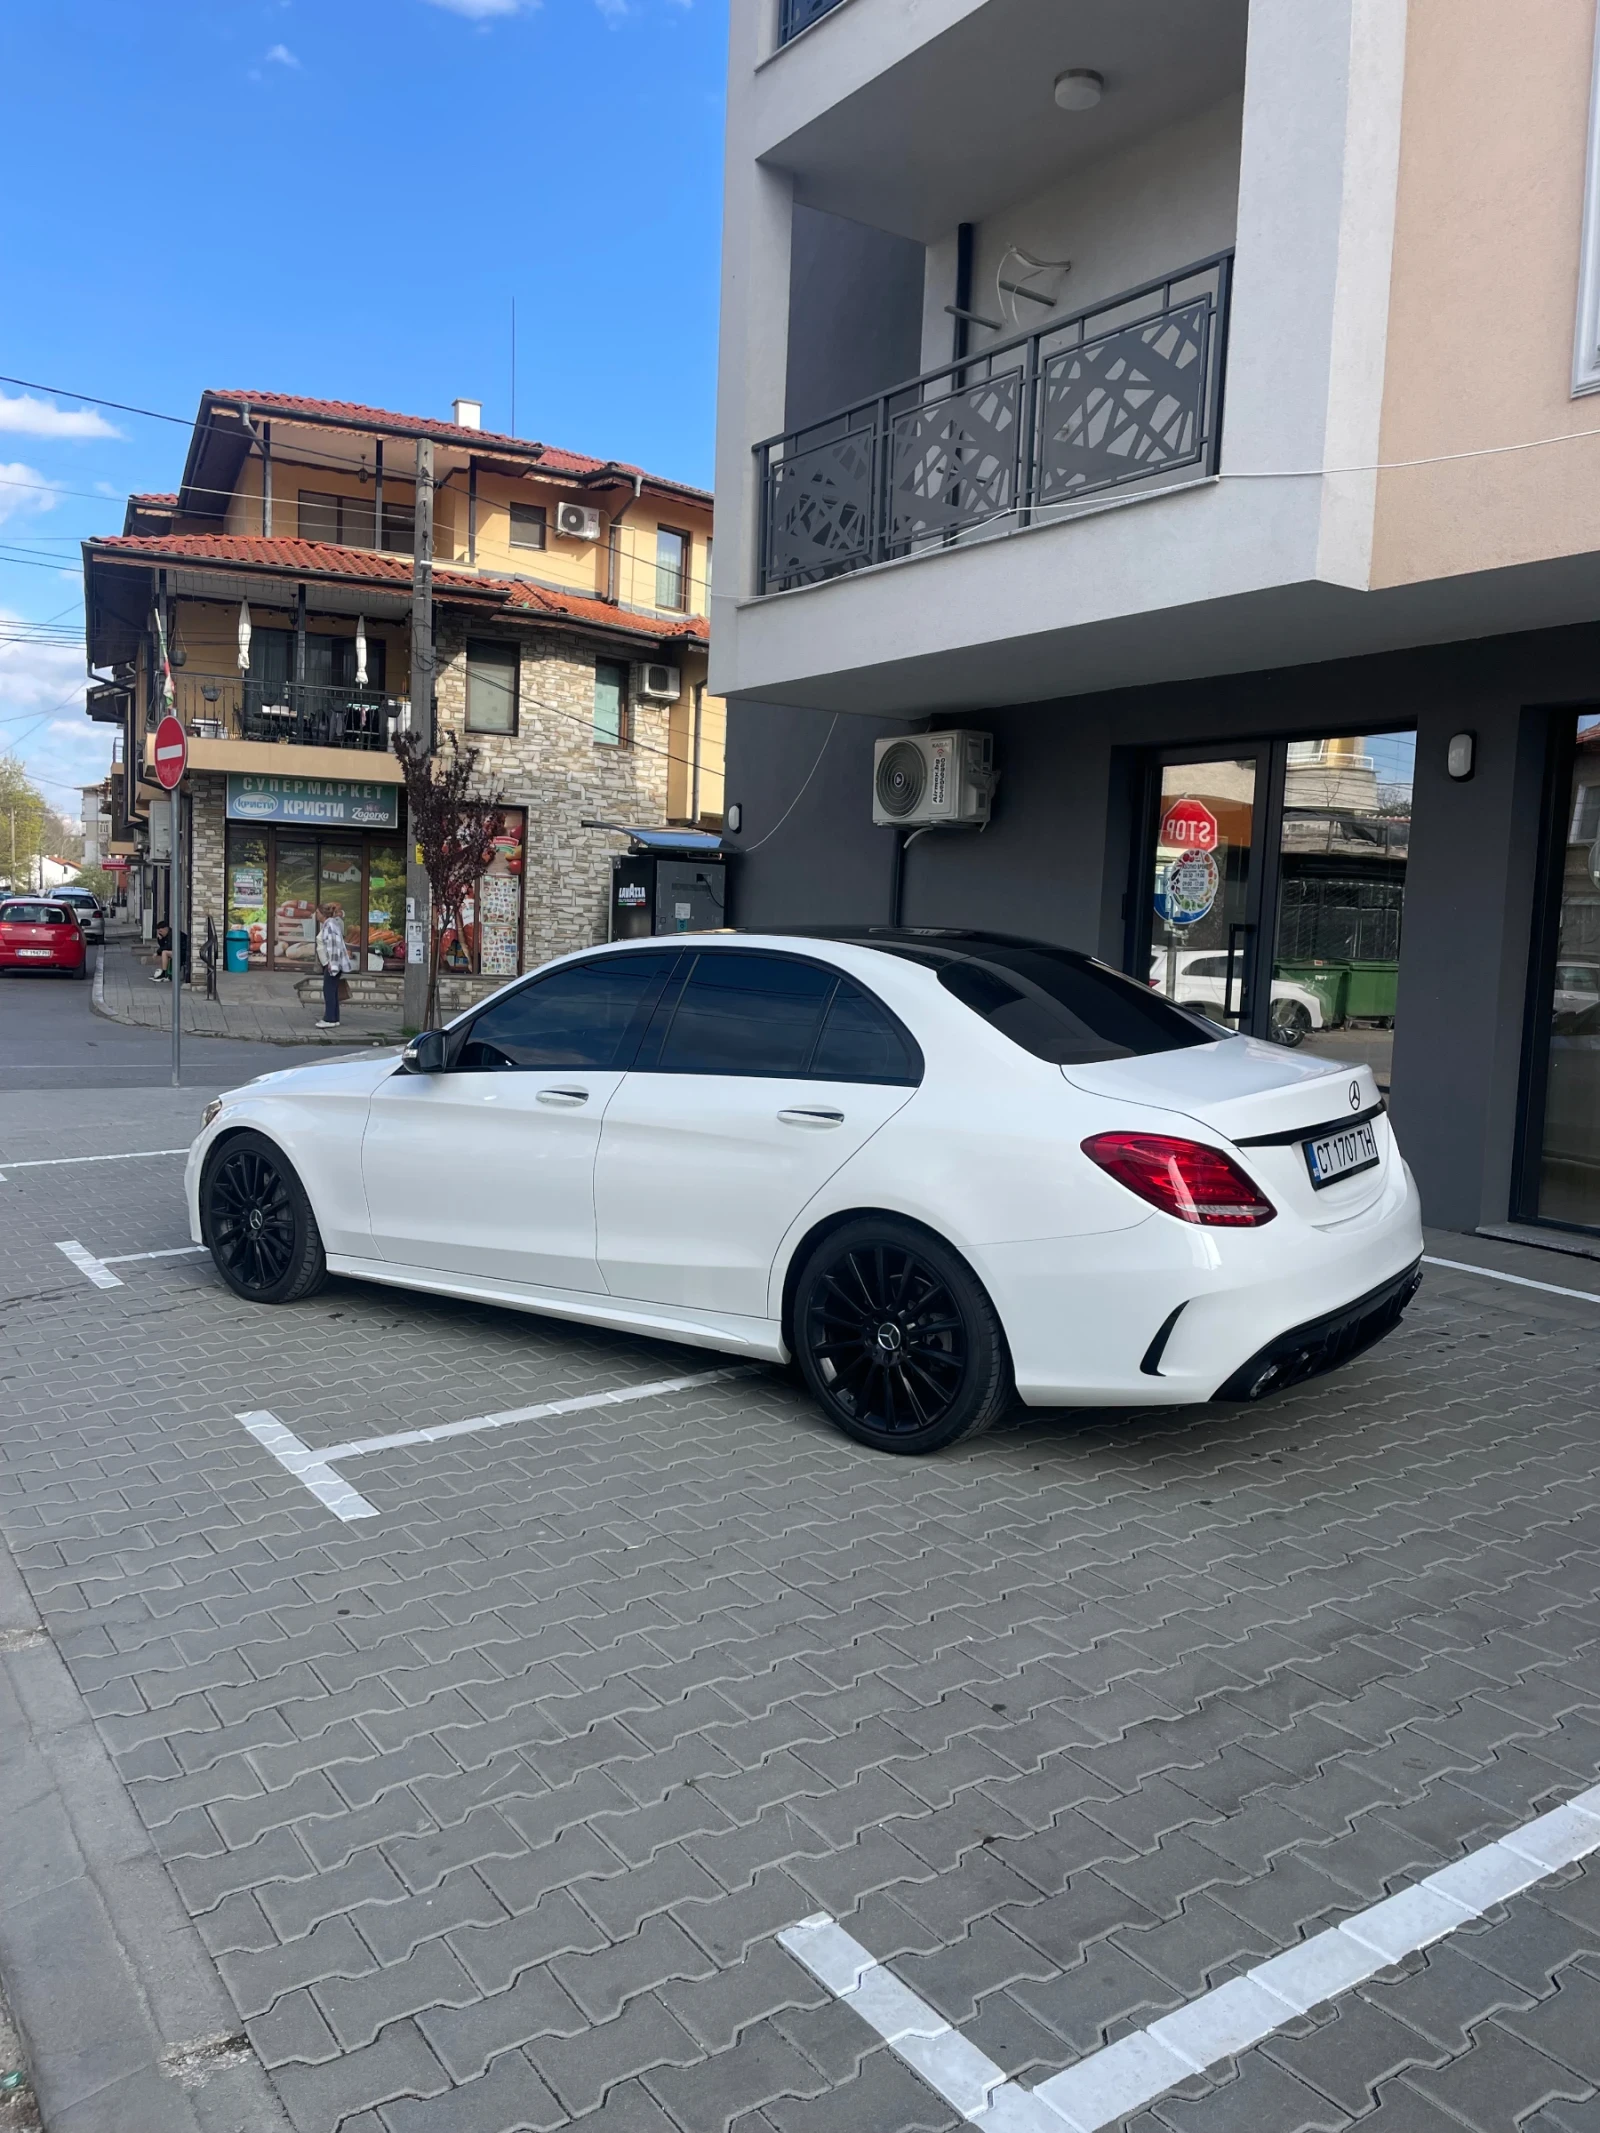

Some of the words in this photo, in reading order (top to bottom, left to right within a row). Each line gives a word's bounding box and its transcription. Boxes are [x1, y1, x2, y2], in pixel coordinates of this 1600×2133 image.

[242, 777, 383, 799] СУПЕРМАРКЕТ
[237, 798, 274, 810] КРИСТИ
[283, 799, 344, 818] КРИСТИ
[351, 806, 389, 821] Zagorka
[618, 882, 646, 898] LAVAZZA
[1317, 1142, 1334, 1174] CT
[1333, 1132, 1358, 1167] 1707
[1357, 1127, 1375, 1157] TH
